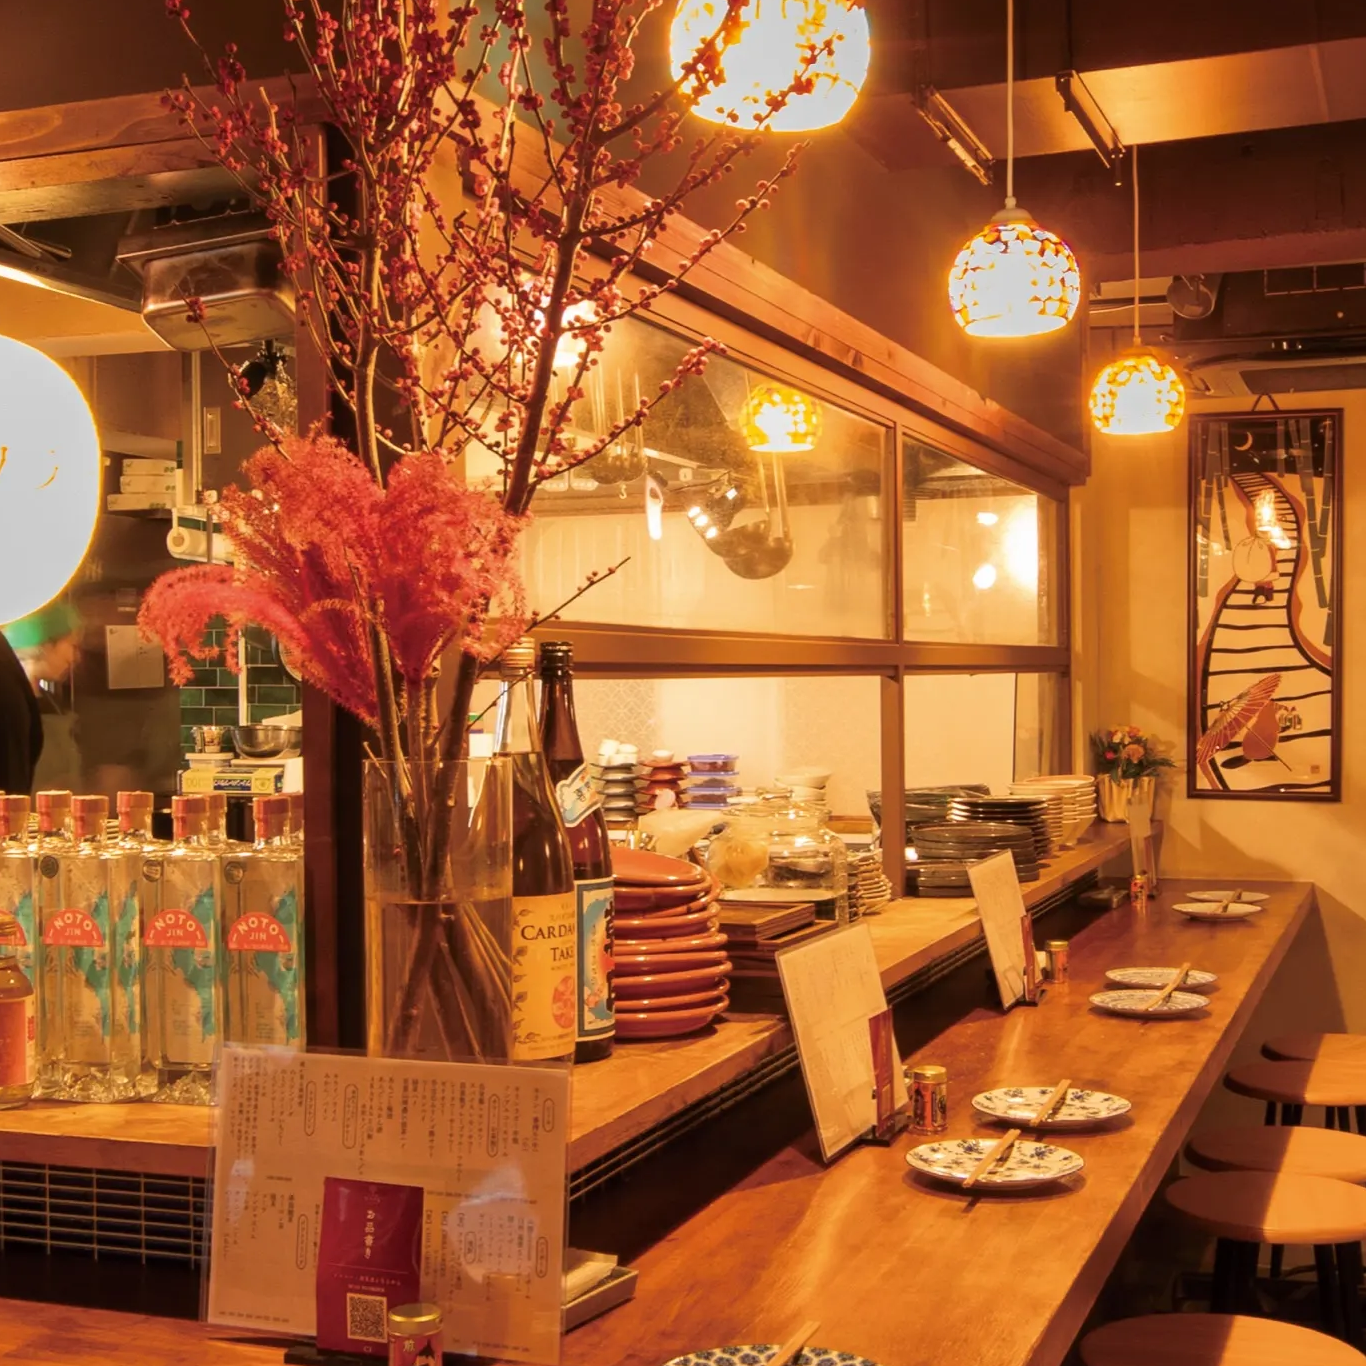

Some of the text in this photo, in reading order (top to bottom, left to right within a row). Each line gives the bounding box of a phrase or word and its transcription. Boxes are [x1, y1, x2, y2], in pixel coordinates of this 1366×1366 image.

[54, 912, 93, 931] NOTO
[154, 913, 196, 931] NOTO
[237, 916, 279, 935] NOTO
[65, 927, 81, 936] JIN
[166, 929, 183, 937] JIN
[249, 931, 267, 940] JIN
[363, 1209, 376, 1260] お品書き
